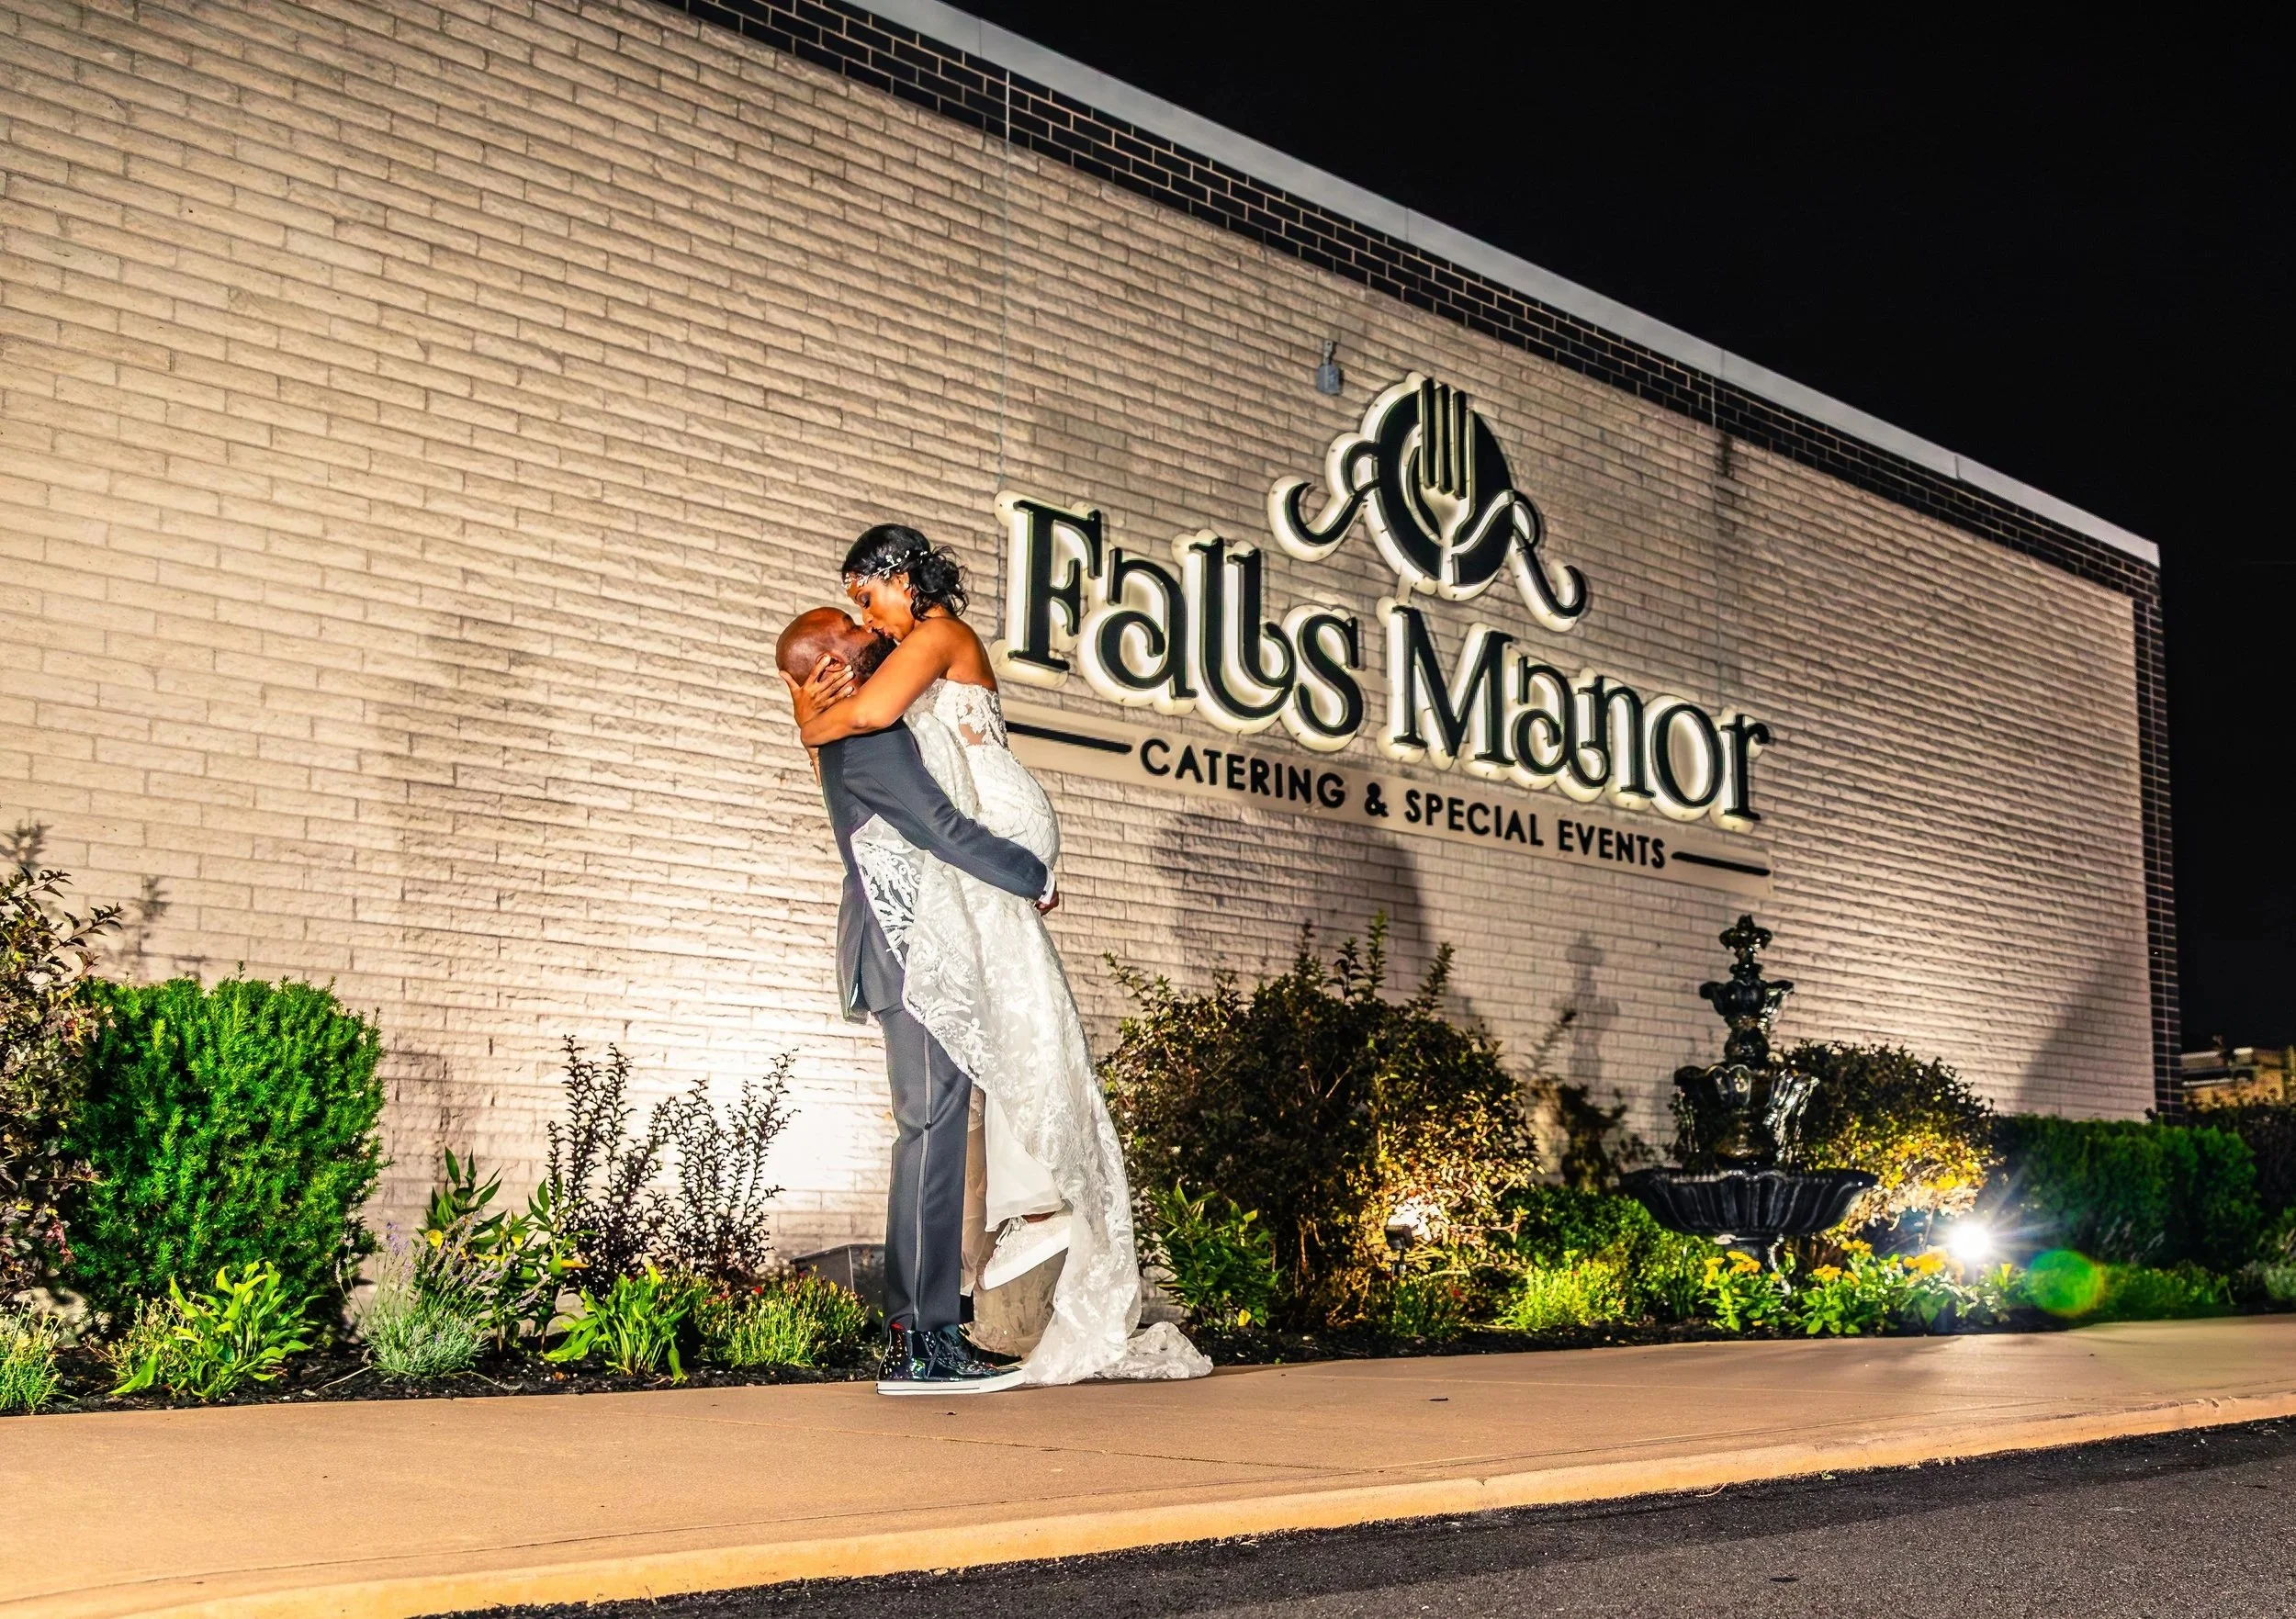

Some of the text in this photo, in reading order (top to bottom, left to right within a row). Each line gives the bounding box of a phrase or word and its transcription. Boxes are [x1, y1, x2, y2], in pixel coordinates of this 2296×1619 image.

[1008, 498, 1771, 823] Falls Manor
[1140, 738, 1666, 869] CATERING & SPECIAL EVENTS
